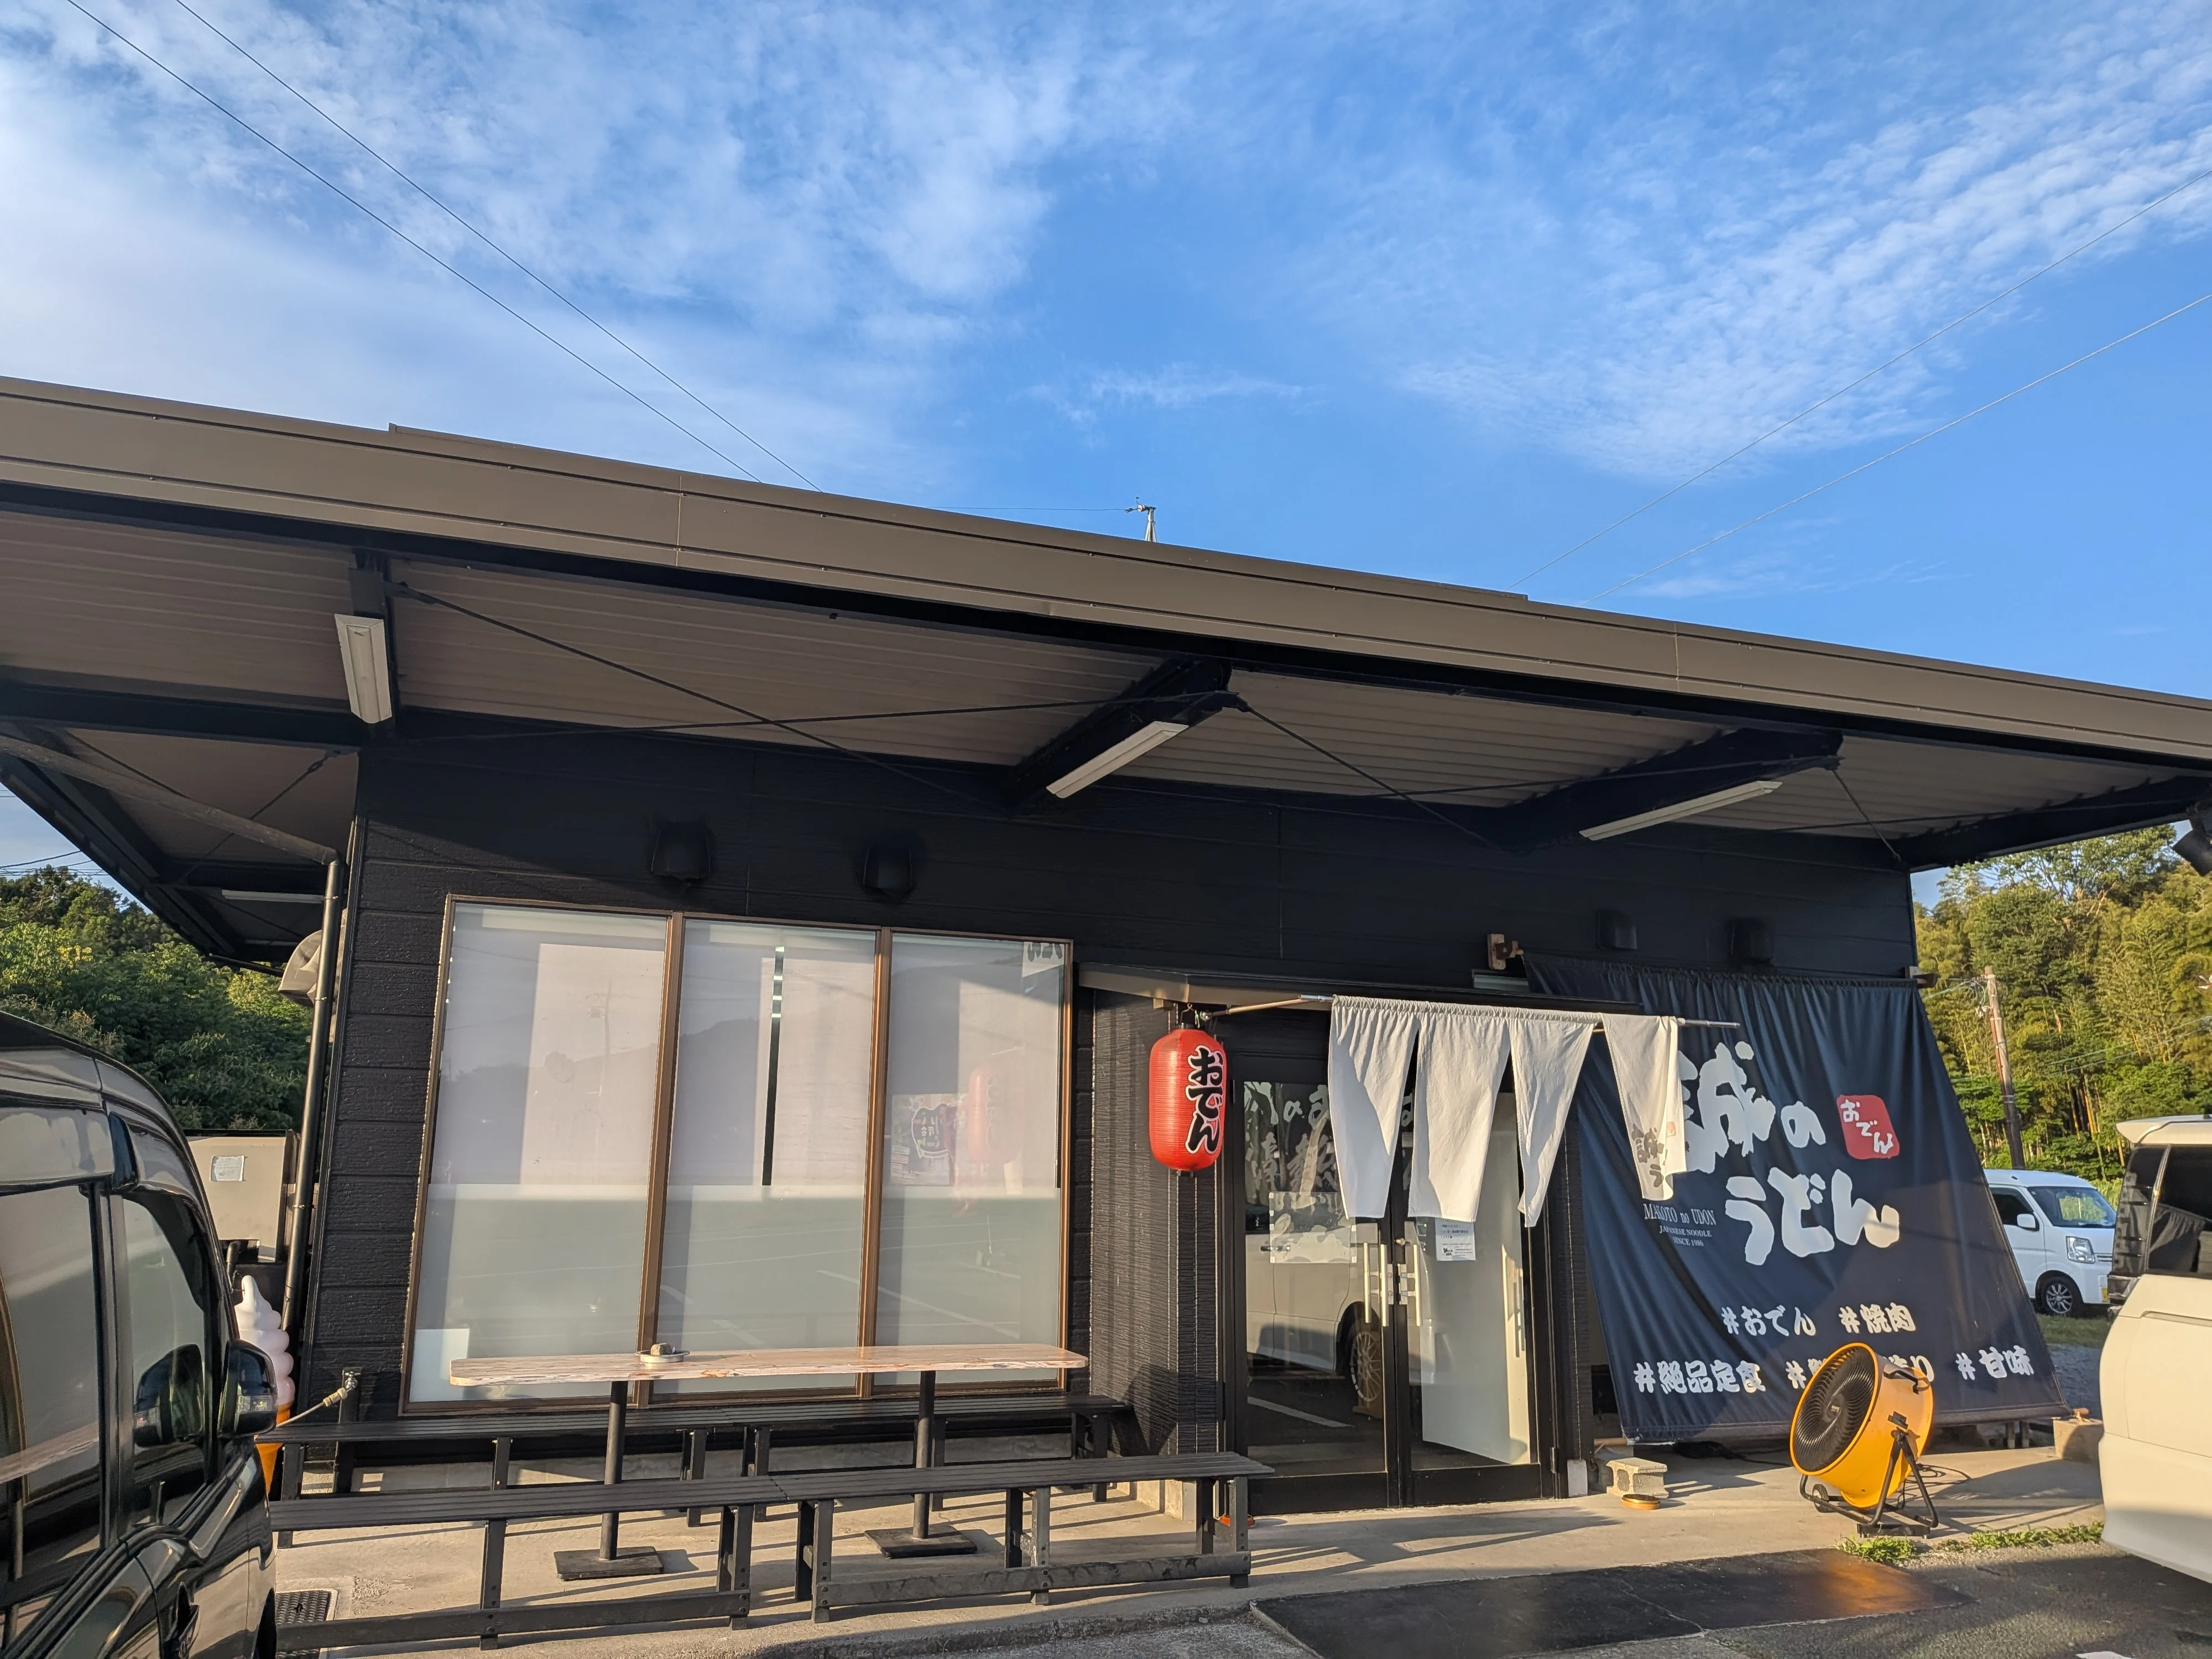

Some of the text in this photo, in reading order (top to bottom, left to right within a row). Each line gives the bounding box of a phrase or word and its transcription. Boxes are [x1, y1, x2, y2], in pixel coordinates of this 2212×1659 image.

[1186, 1046, 1223, 1154] おでん
[1840, 1099, 1893, 1154] おでん
[1643, 1203, 1717, 1225] MAKOTO no UDON
[1660, 1225, 1712, 1237] JAPANESE NOODLE
[1725, 1167, 1900, 1265] うどん
[1672, 1237, 1691, 1246] SINCE
